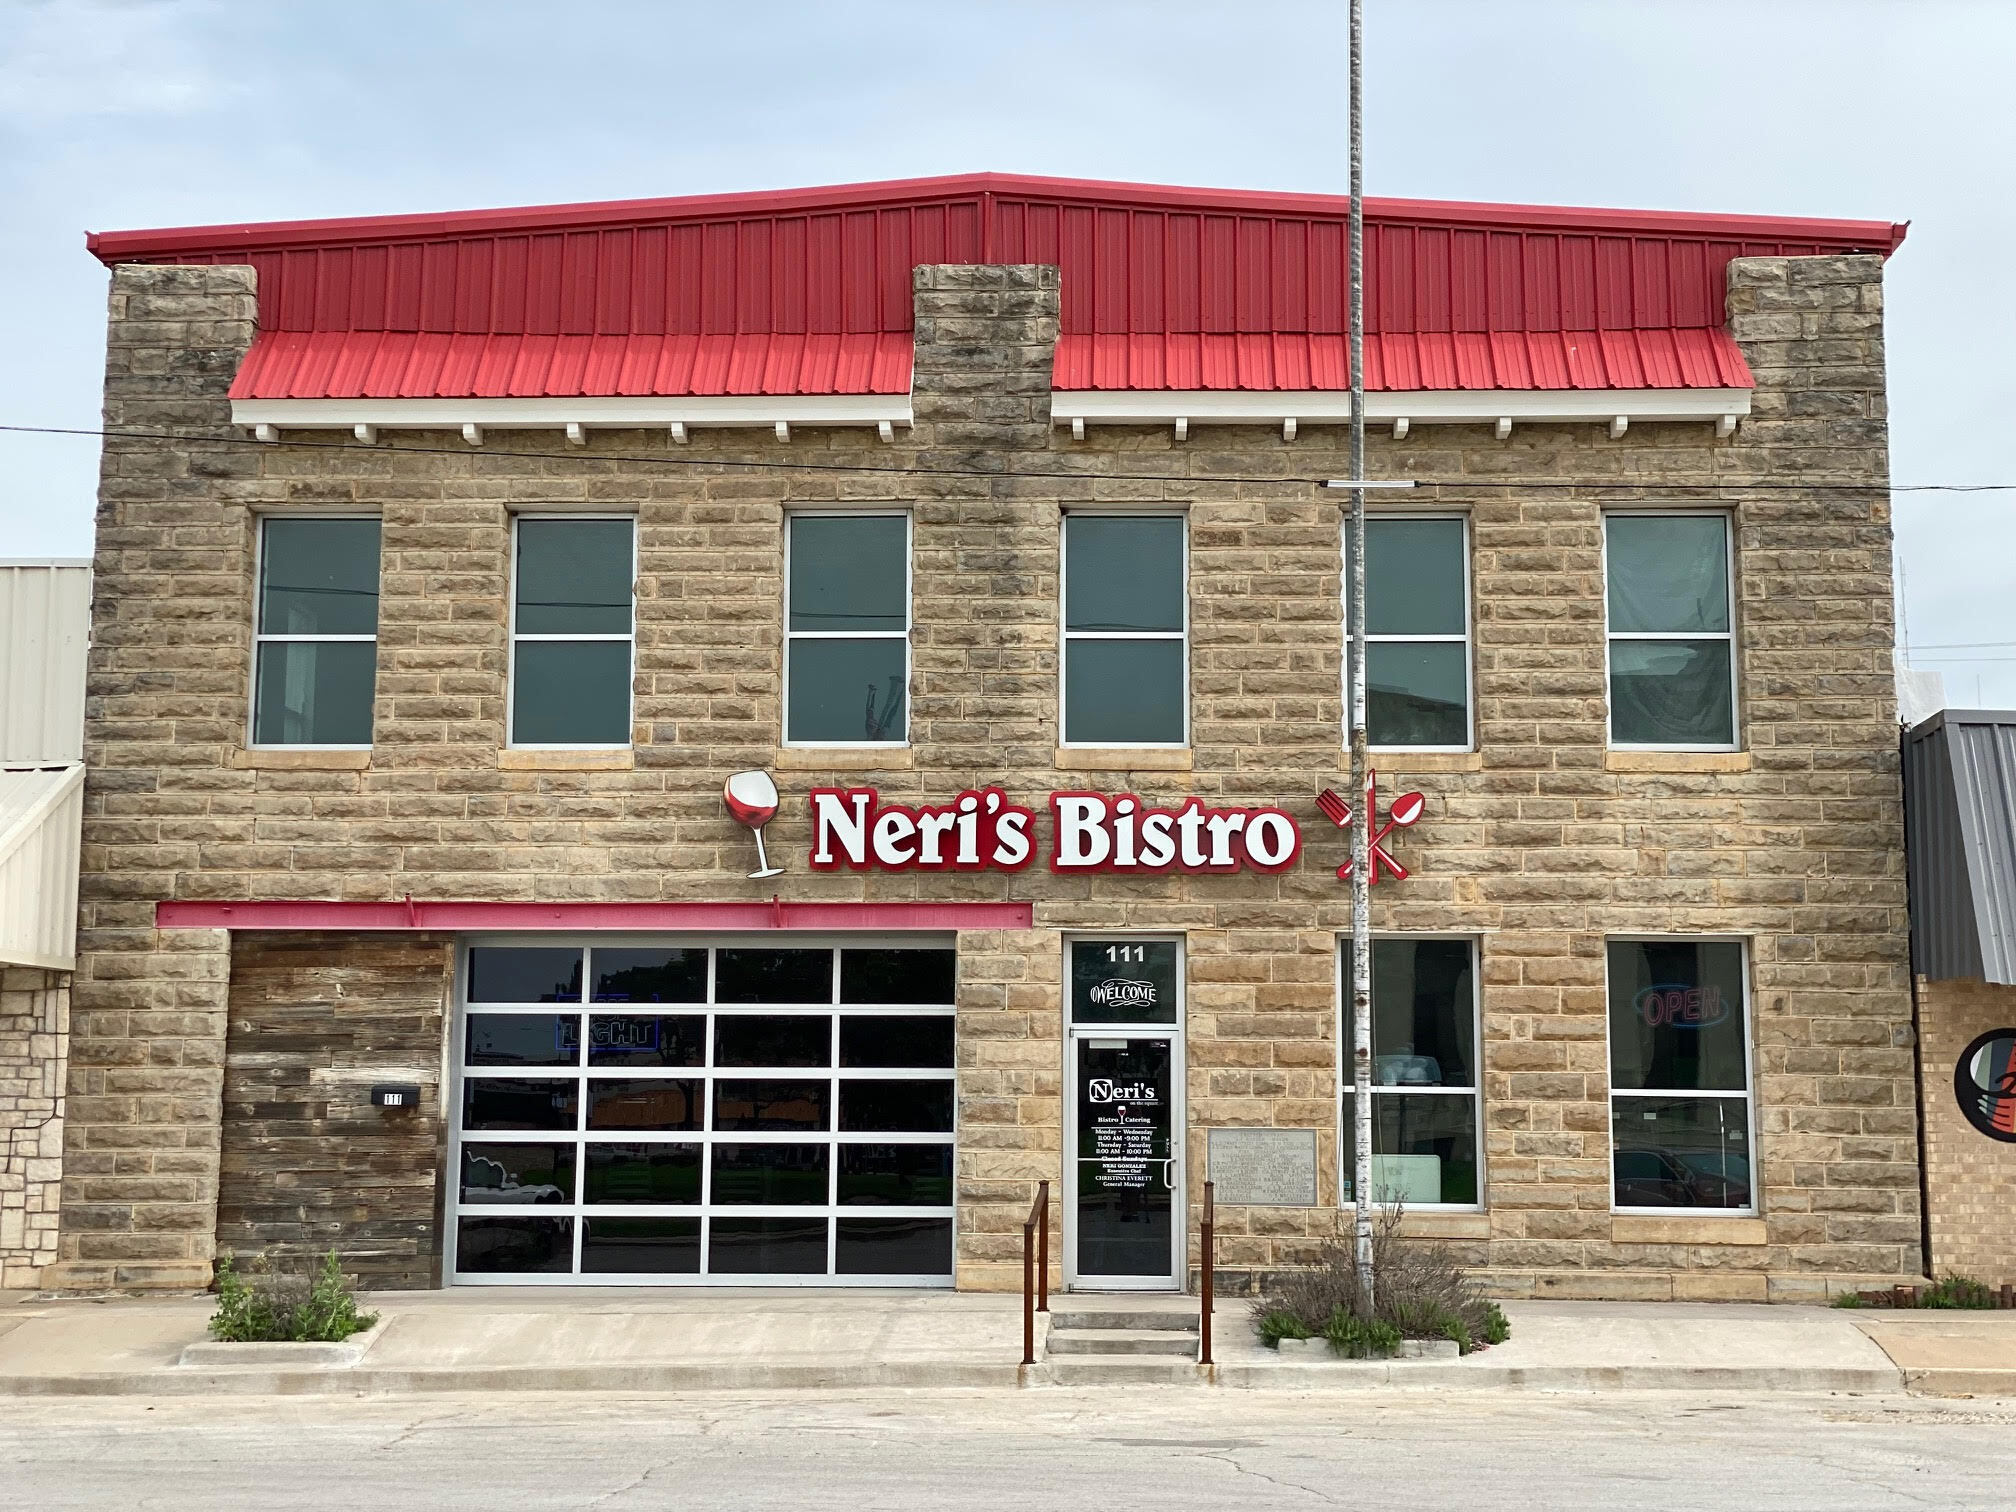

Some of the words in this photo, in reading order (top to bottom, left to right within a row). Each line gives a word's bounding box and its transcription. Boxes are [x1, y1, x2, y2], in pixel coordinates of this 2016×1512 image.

[814, 792, 1030, 866] Neri's
[1056, 796, 1296, 867] Bistro
[1106, 945, 1144, 962] 111
[1090, 982, 1157, 1005] WELCOME
[1643, 985, 1720, 1026] OPEN
[562, 1021, 652, 1046] LGHT
[385, 1094, 401, 1105] 111
[1093, 1082, 1155, 1099] Neri's
